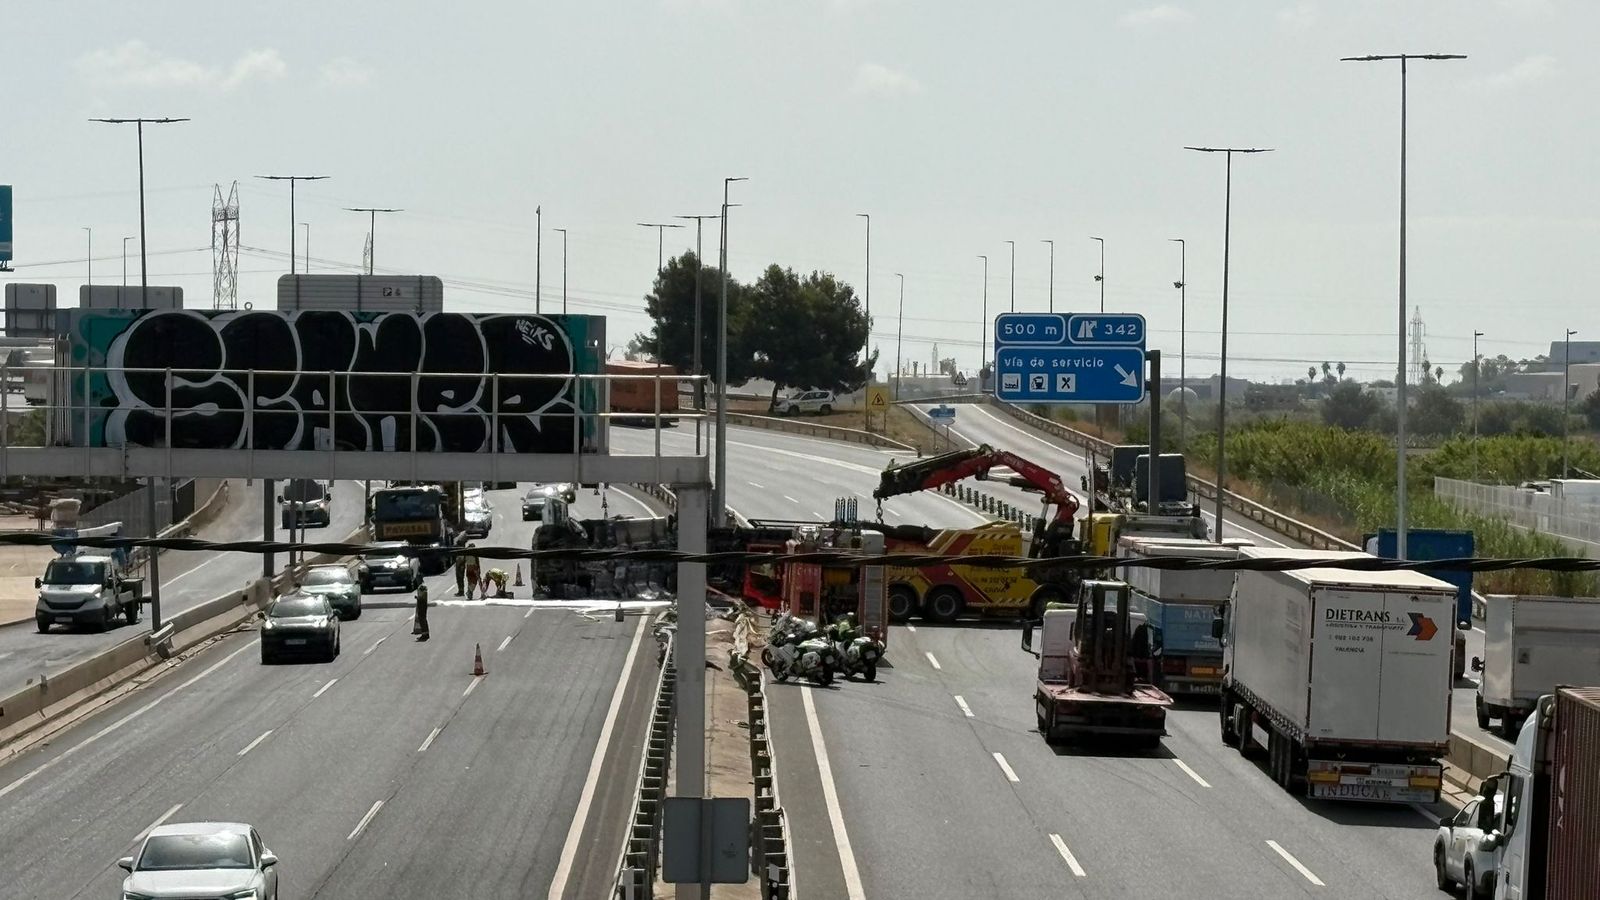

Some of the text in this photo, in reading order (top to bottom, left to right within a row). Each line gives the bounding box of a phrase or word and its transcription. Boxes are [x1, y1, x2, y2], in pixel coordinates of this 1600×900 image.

[1004, 324, 1057, 335] 500 m
[1105, 324, 1136, 335] 342
[1004, 356, 1104, 367] vía de servicio
[1326, 608, 1390, 623] DIETRANS
